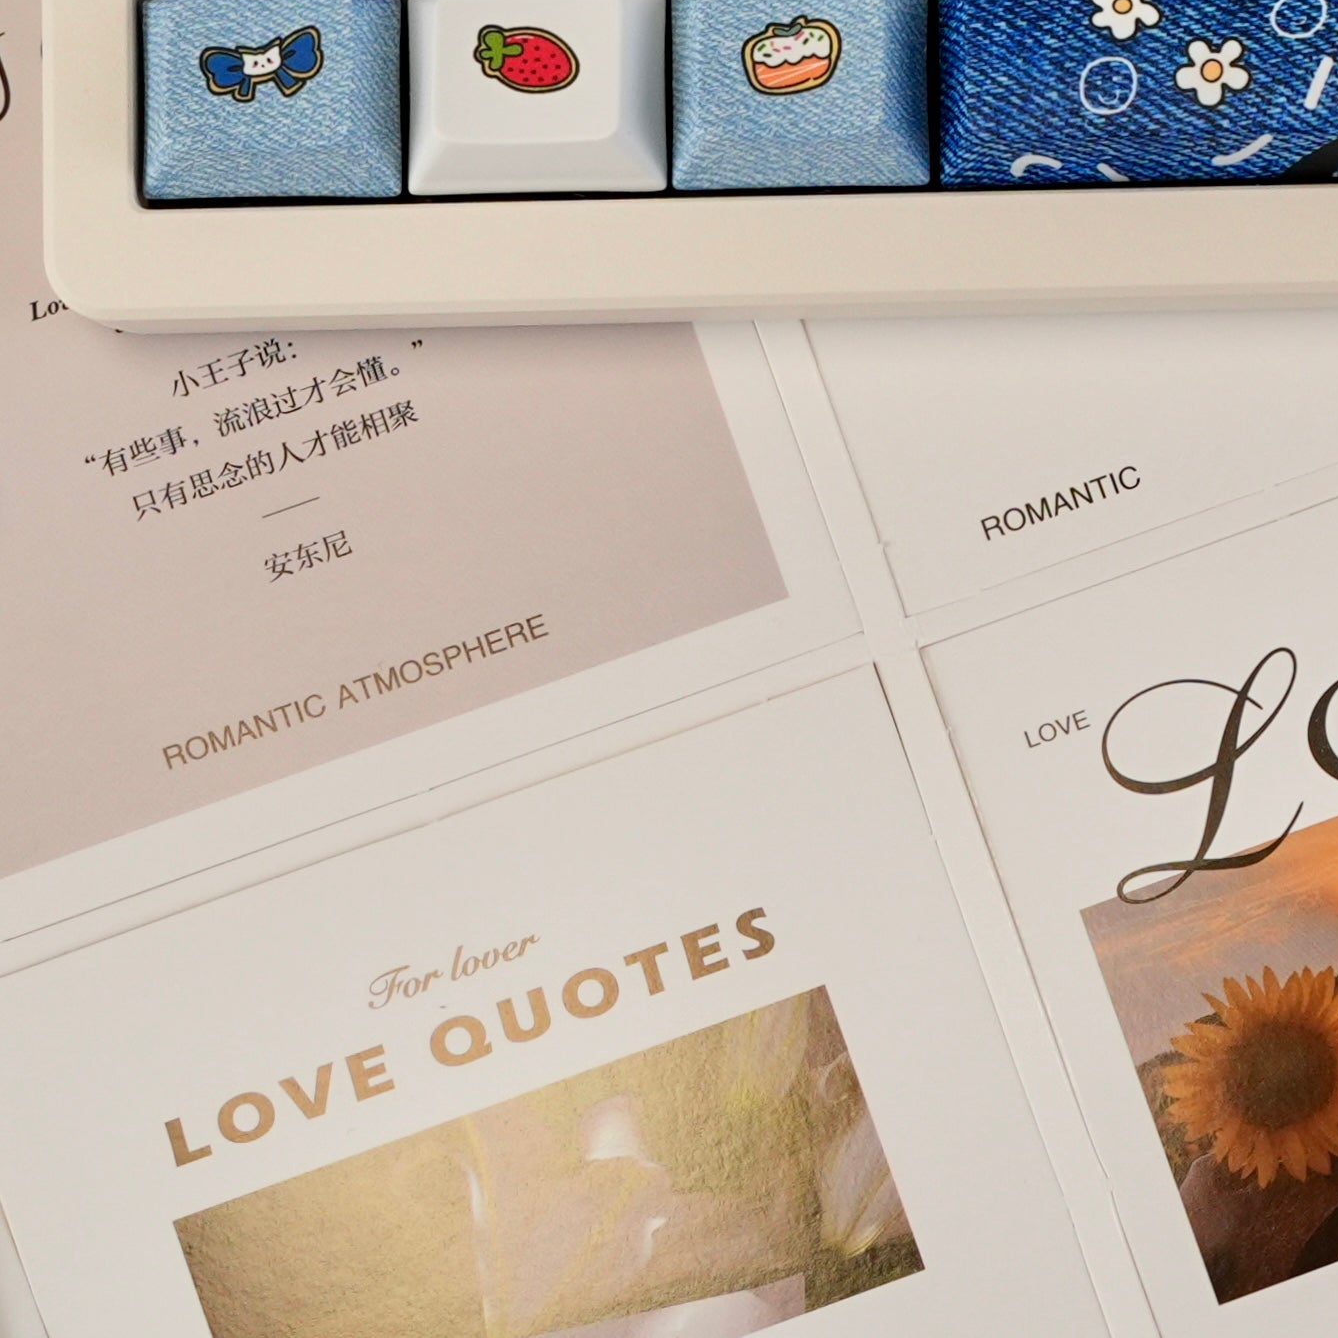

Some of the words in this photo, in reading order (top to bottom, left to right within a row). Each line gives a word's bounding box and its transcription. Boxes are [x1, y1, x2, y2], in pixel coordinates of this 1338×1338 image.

[132, 399, 420, 521] 只有思念的人才能相聚
[980, 465, 1142, 542] ROMANTIC
[263, 530, 353, 583] 安东尼
[162, 694, 326, 770] ROMANTIC
[338, 613, 549, 709] ATMOSPHERE
[1023, 709, 1092, 749] LOVE
[368, 964, 442, 1009] For
[450, 932, 540, 982] lover
[165, 1044, 395, 1167] LOVE
[430, 906, 776, 1066] QUOTES
